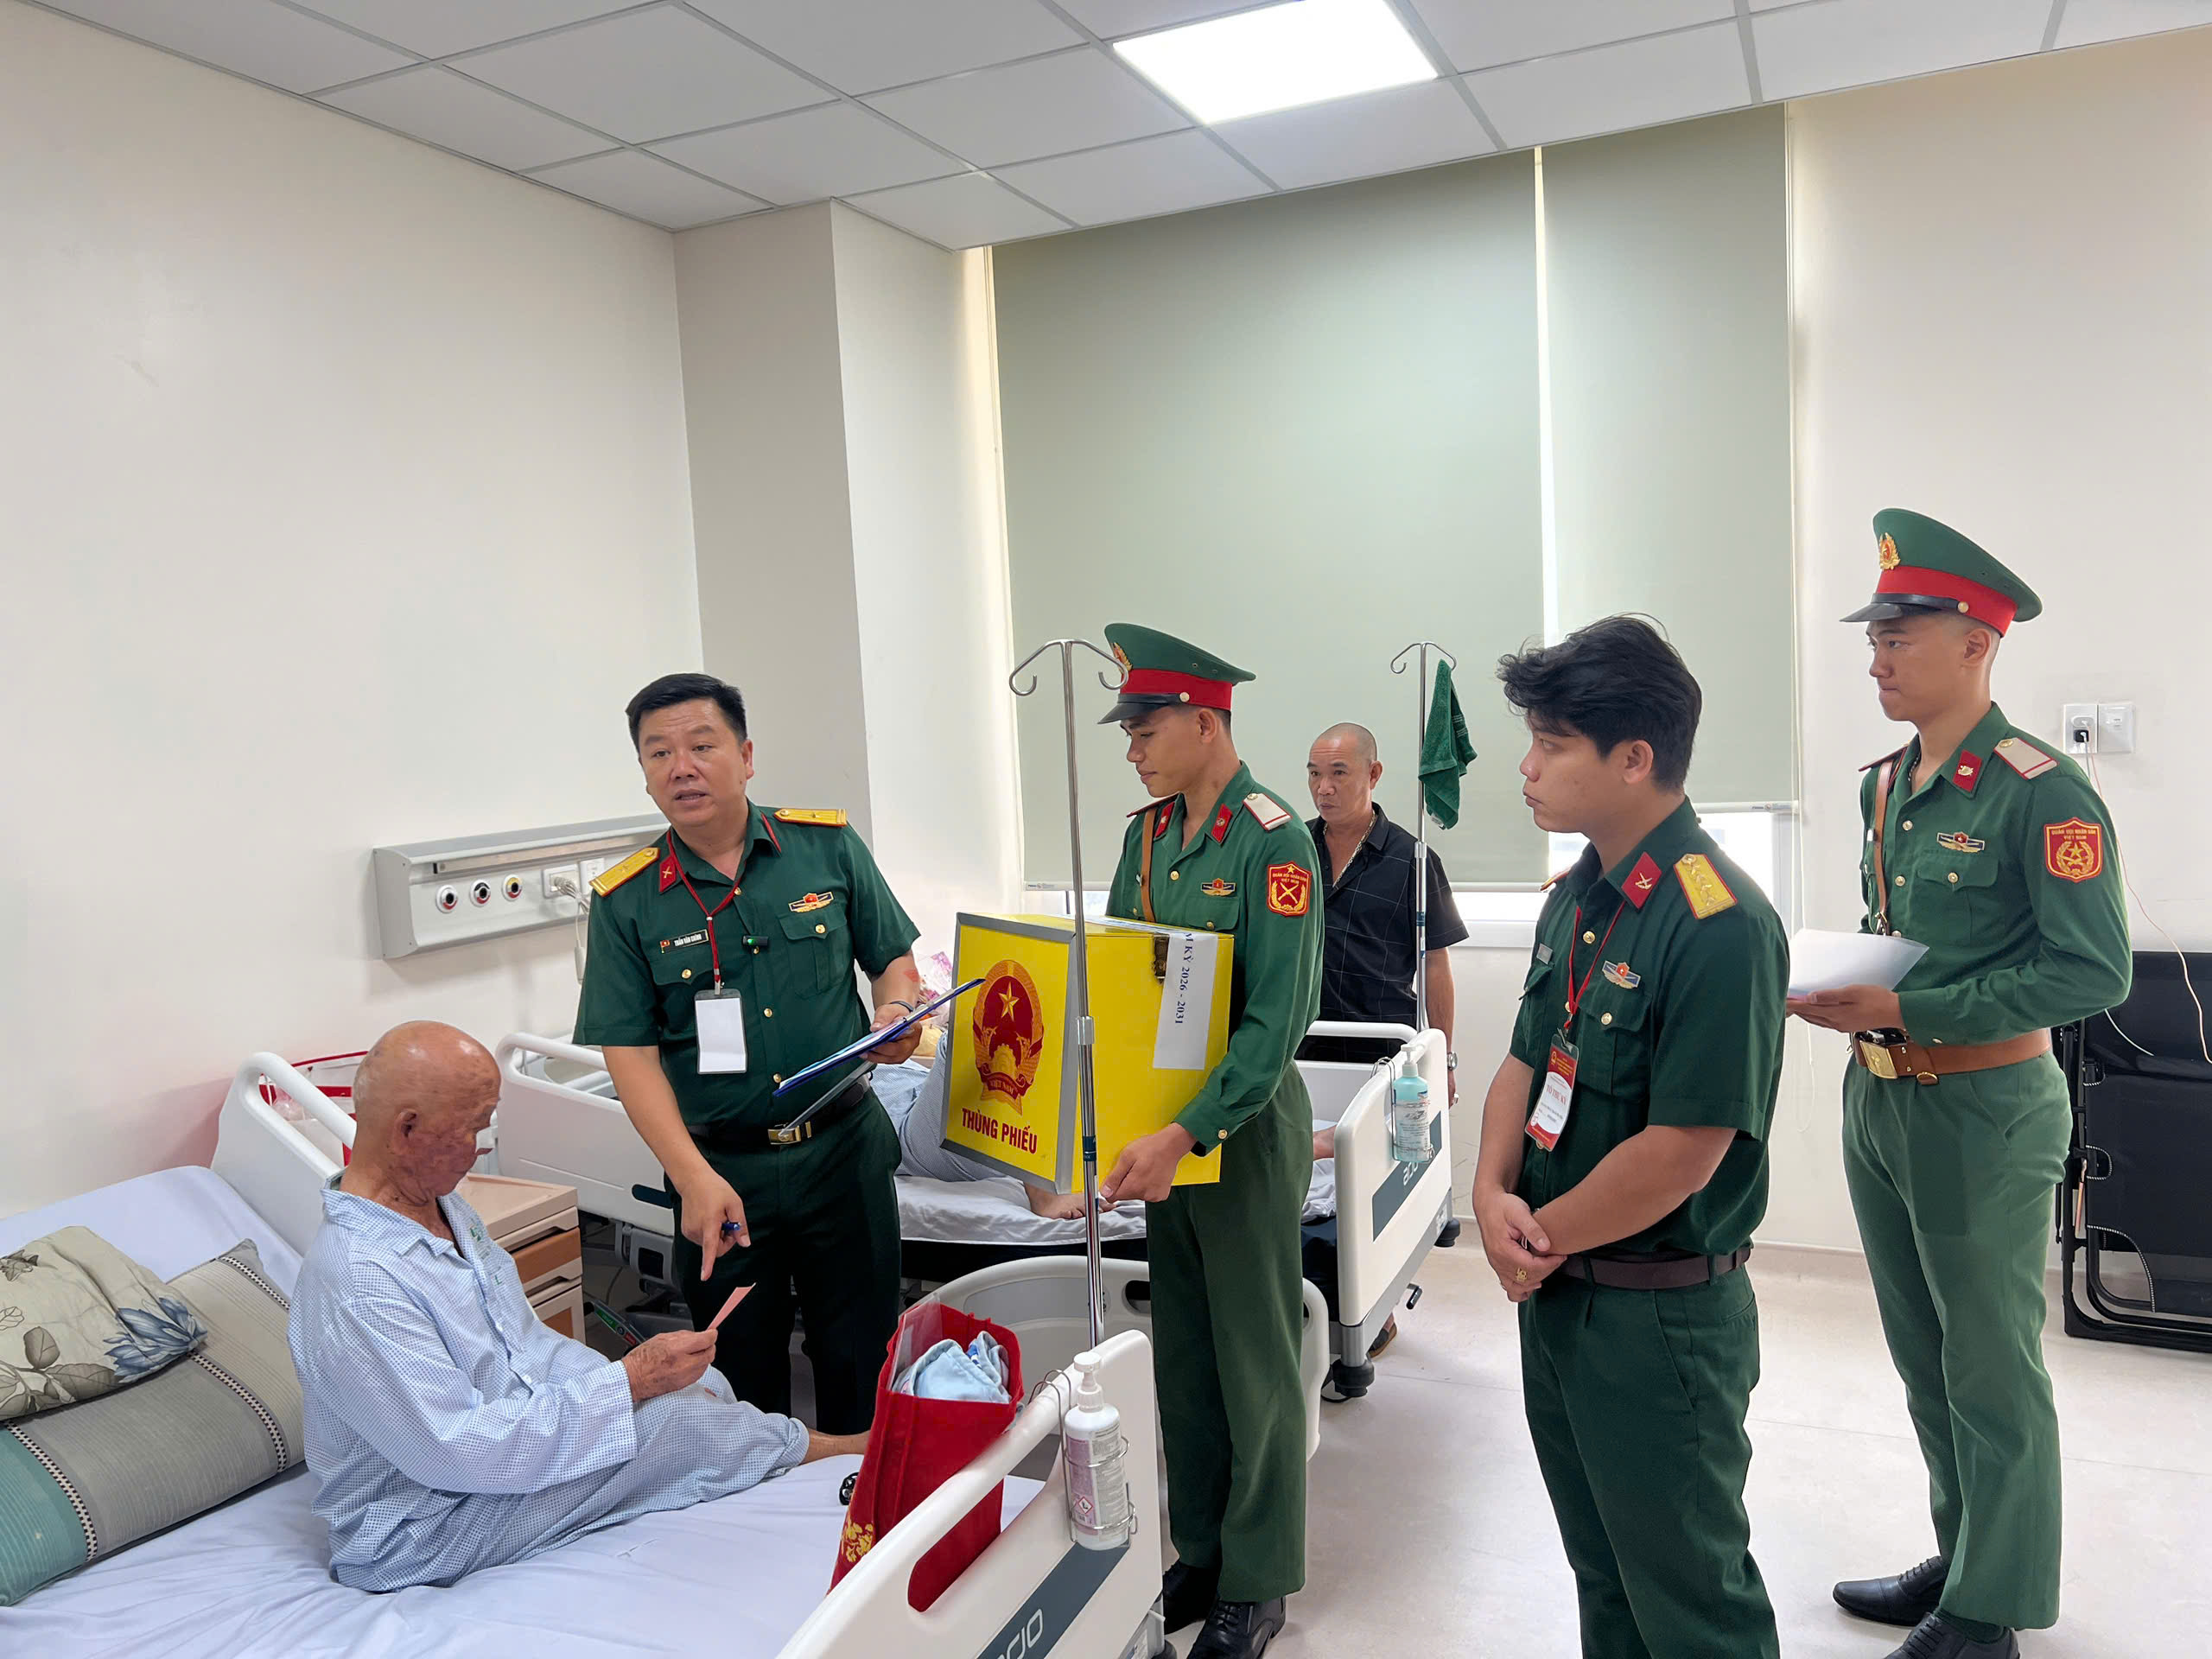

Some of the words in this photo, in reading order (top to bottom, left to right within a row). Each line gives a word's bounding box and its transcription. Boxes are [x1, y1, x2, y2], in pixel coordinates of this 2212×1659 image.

[1179, 967, 1190, 992] 2026
[1175, 1001, 1186, 1025] 2031
[962, 1108, 999, 1141] THÙNG
[1001, 1122, 1038, 1154] PHIẾU
